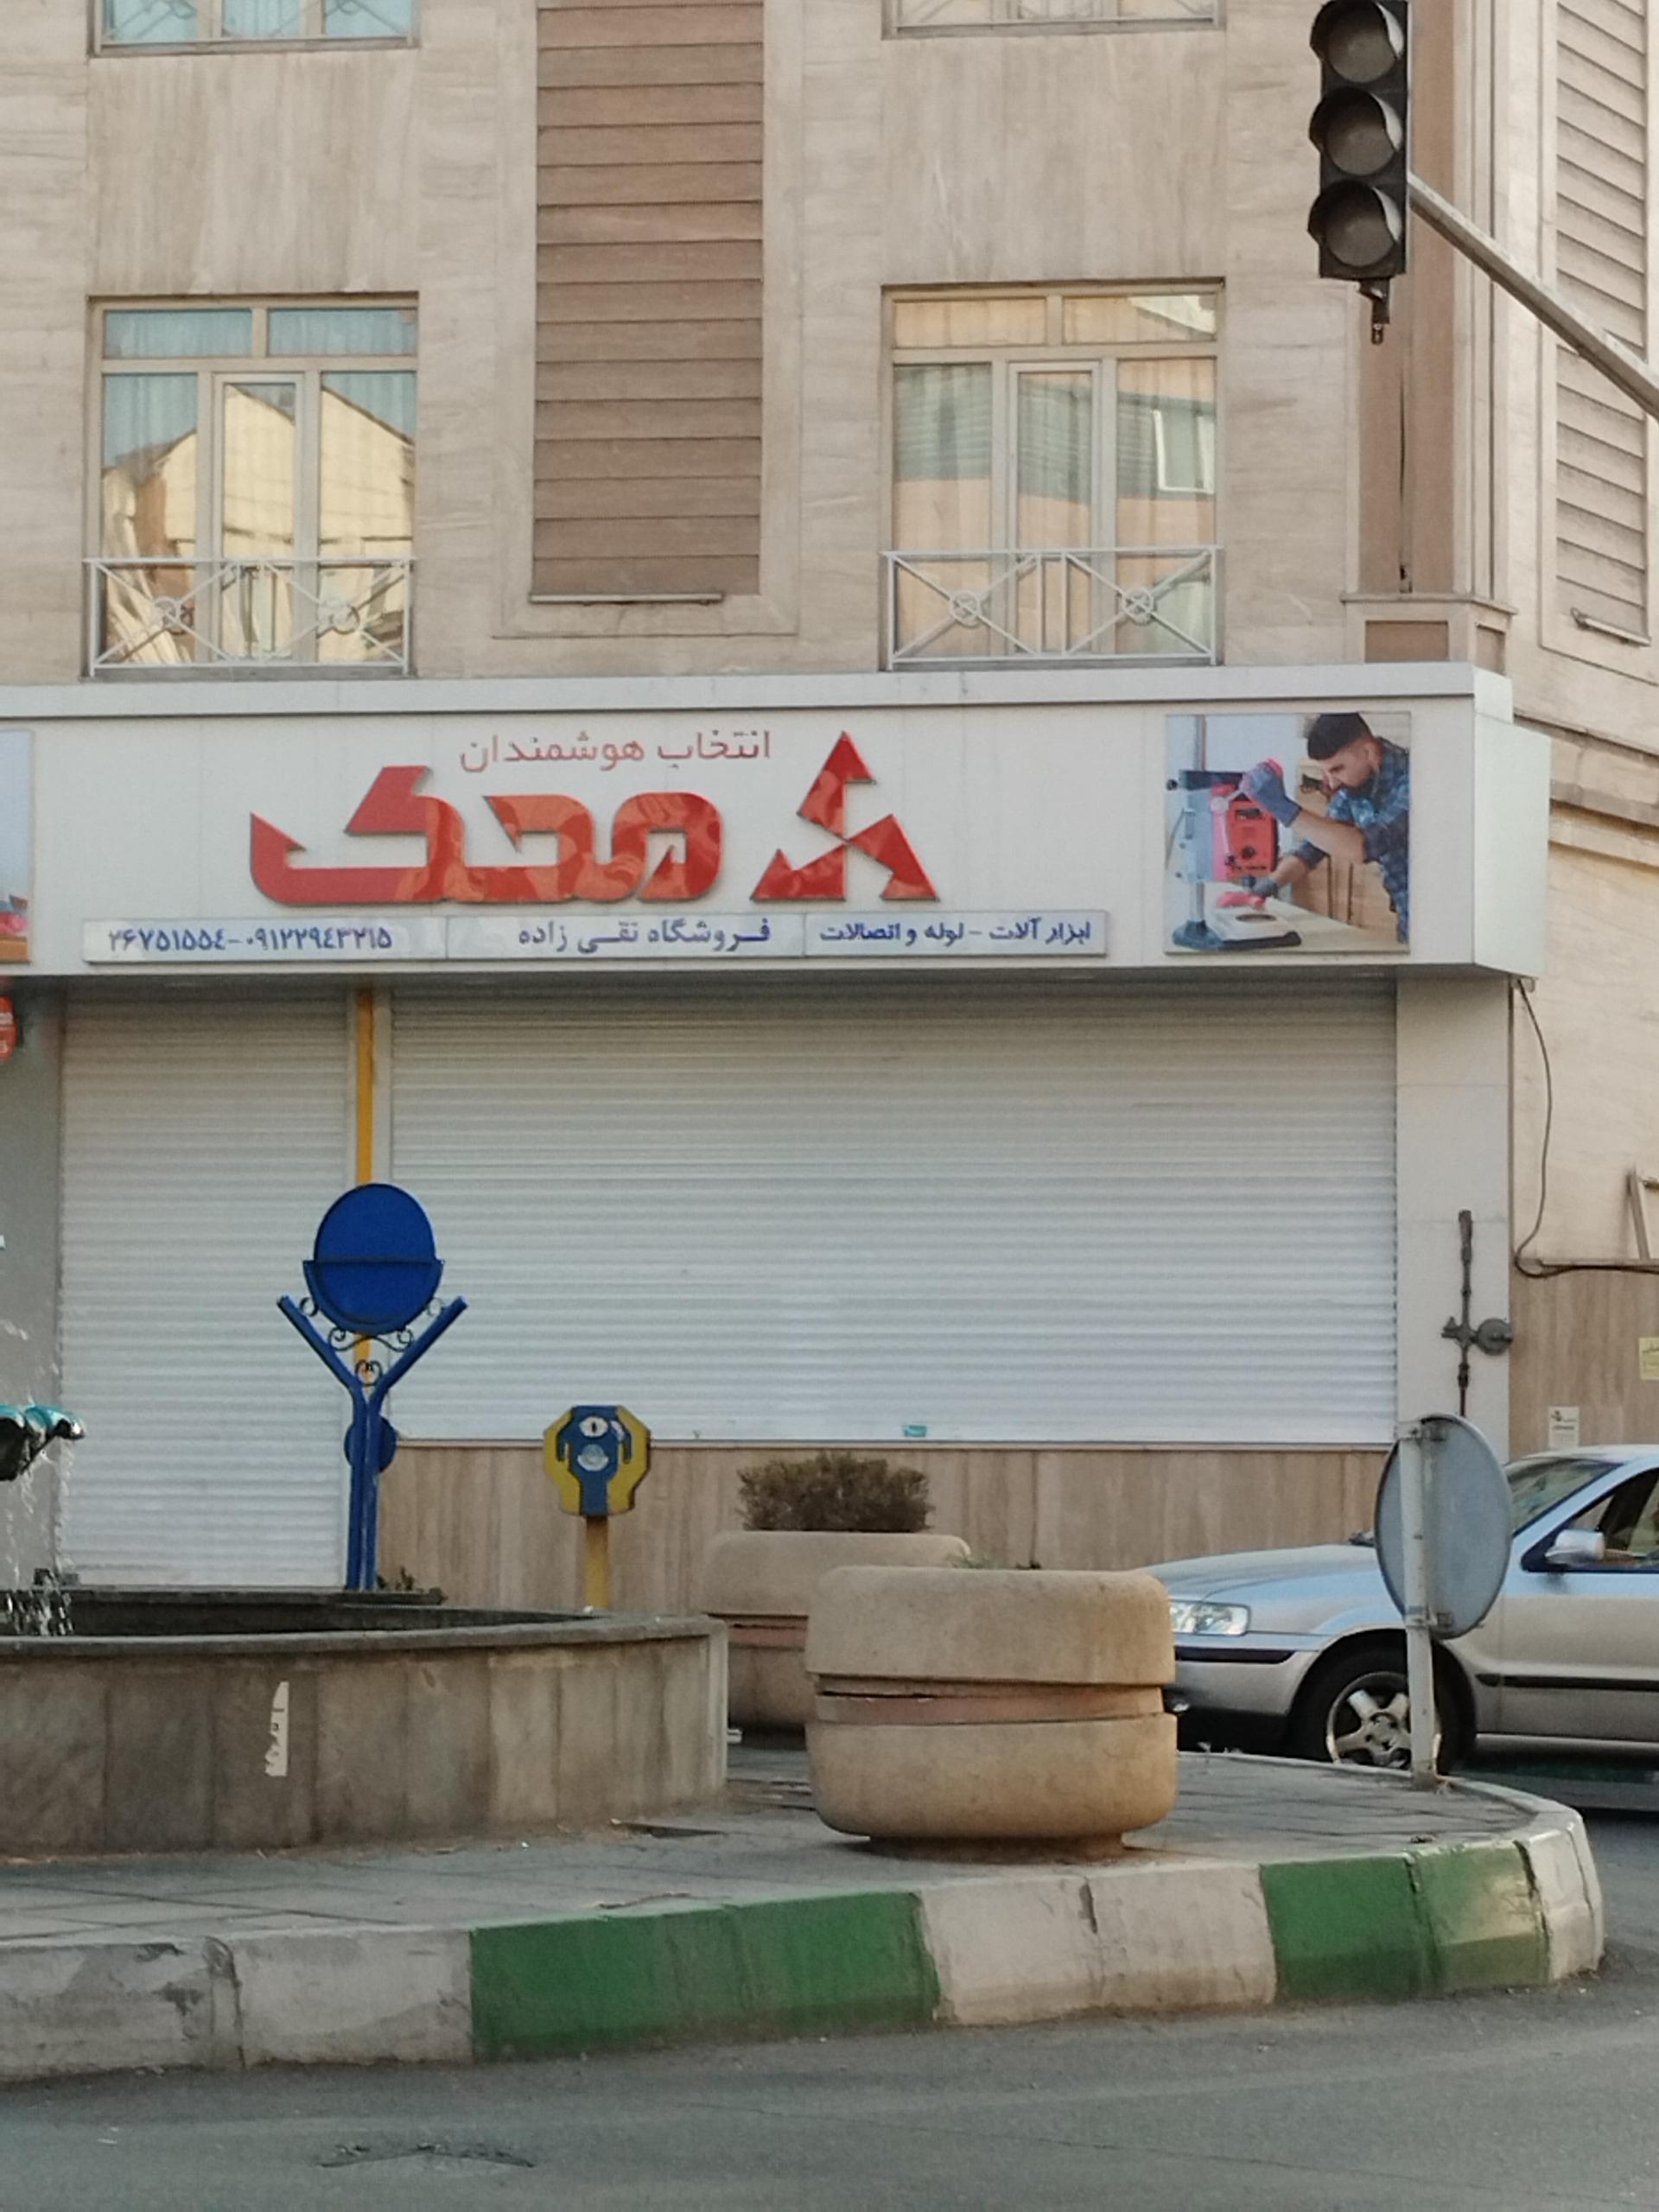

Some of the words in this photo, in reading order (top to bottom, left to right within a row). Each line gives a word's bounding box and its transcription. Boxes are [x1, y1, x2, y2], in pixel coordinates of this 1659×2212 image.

[460, 730, 645, 773] هوشمندان
[658, 730, 770, 770] انتخاب
[518, 919, 567, 952] زاده
[576, 920, 639, 954] تقی
[646, 917, 771, 952] فروشگاه
[819, 922, 901, 941] اتصالات
[905, 927, 918, 947] و
[924, 921, 965, 947] لوله
[988, 916, 1042, 940] آلات
[1045, 920, 1090, 945] ابزار
